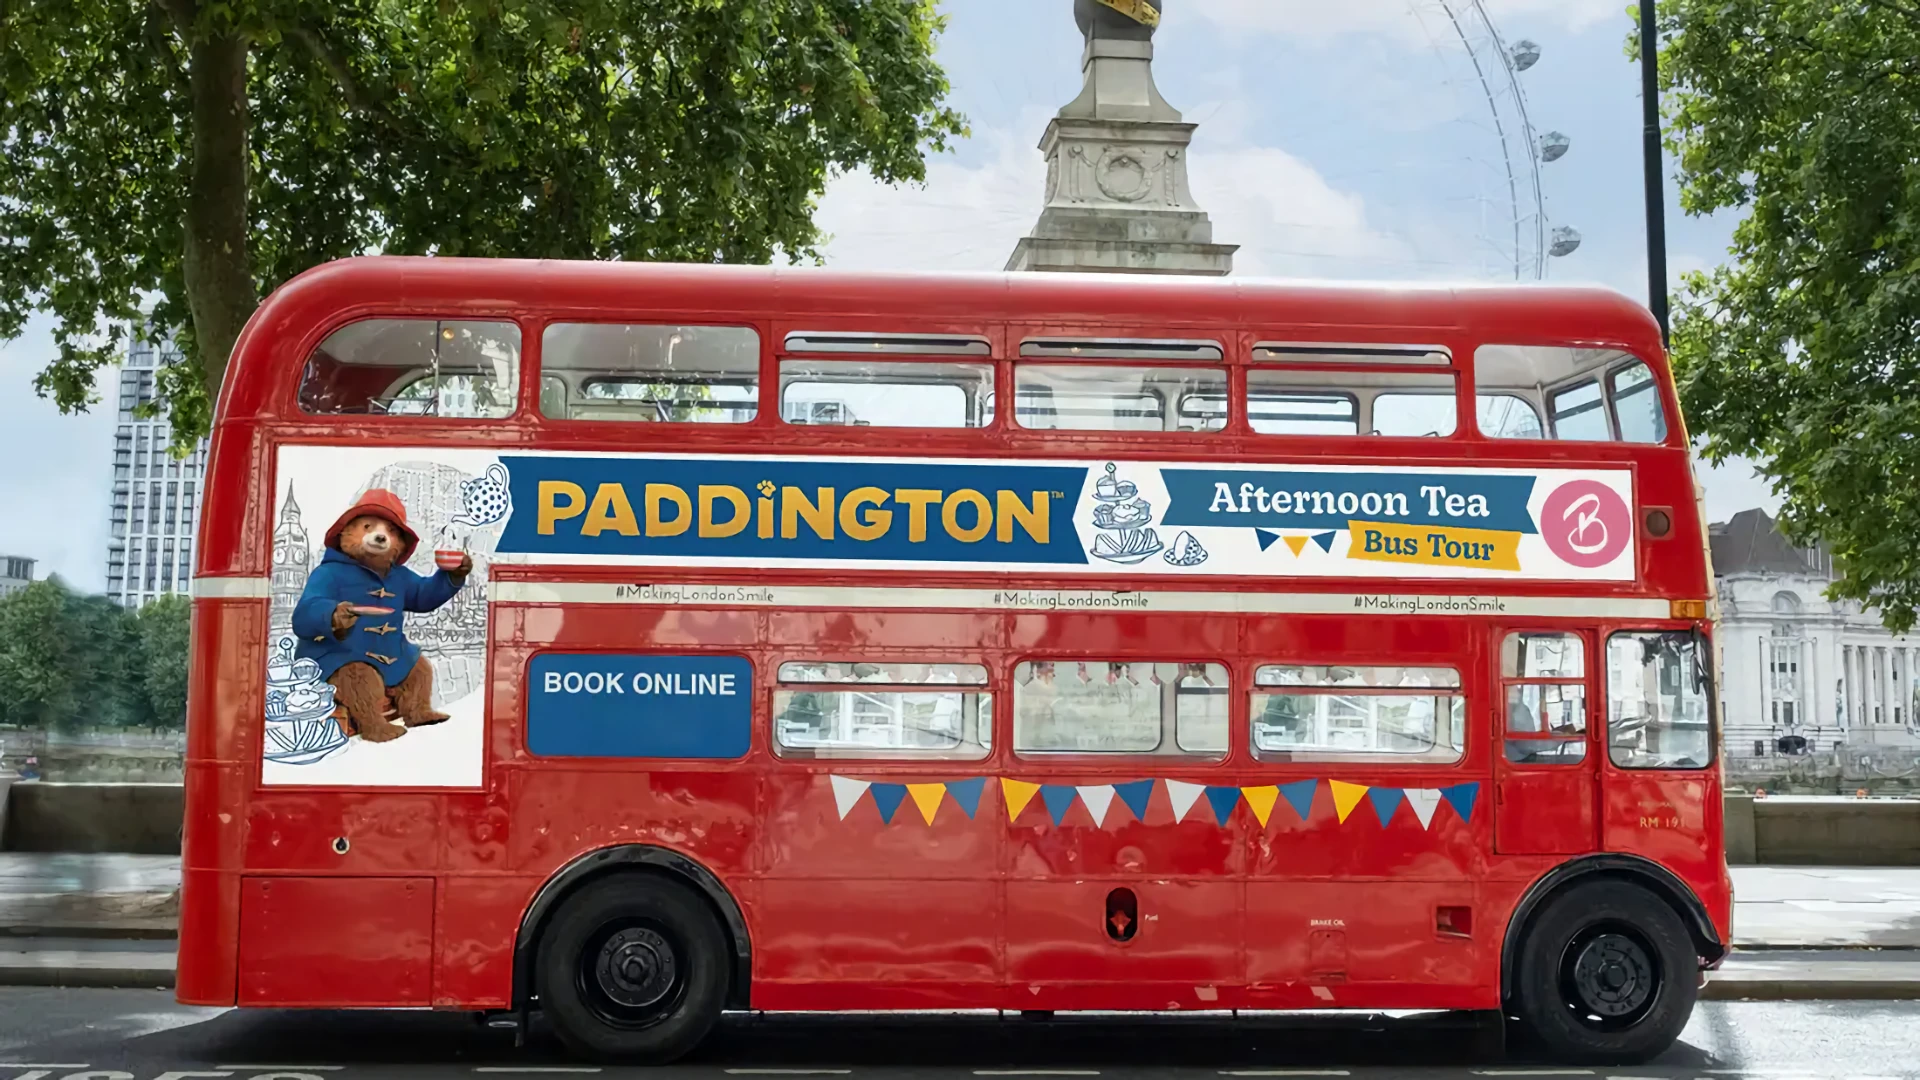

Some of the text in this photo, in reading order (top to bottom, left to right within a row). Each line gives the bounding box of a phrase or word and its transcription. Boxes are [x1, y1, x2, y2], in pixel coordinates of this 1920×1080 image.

[1209, 482, 1490, 517] Afternoon Tea
[1364, 530, 1495, 560] Bus Tour
[616, 586, 774, 604] #MakingLondonSmile
[994, 591, 1149, 610] #MakingLondonSmile
[1354, 595, 1505, 613] #MakingLondonSmile
[544, 672, 736, 695] BOOK ONLINE
[1640, 816, 1659, 828] RM
